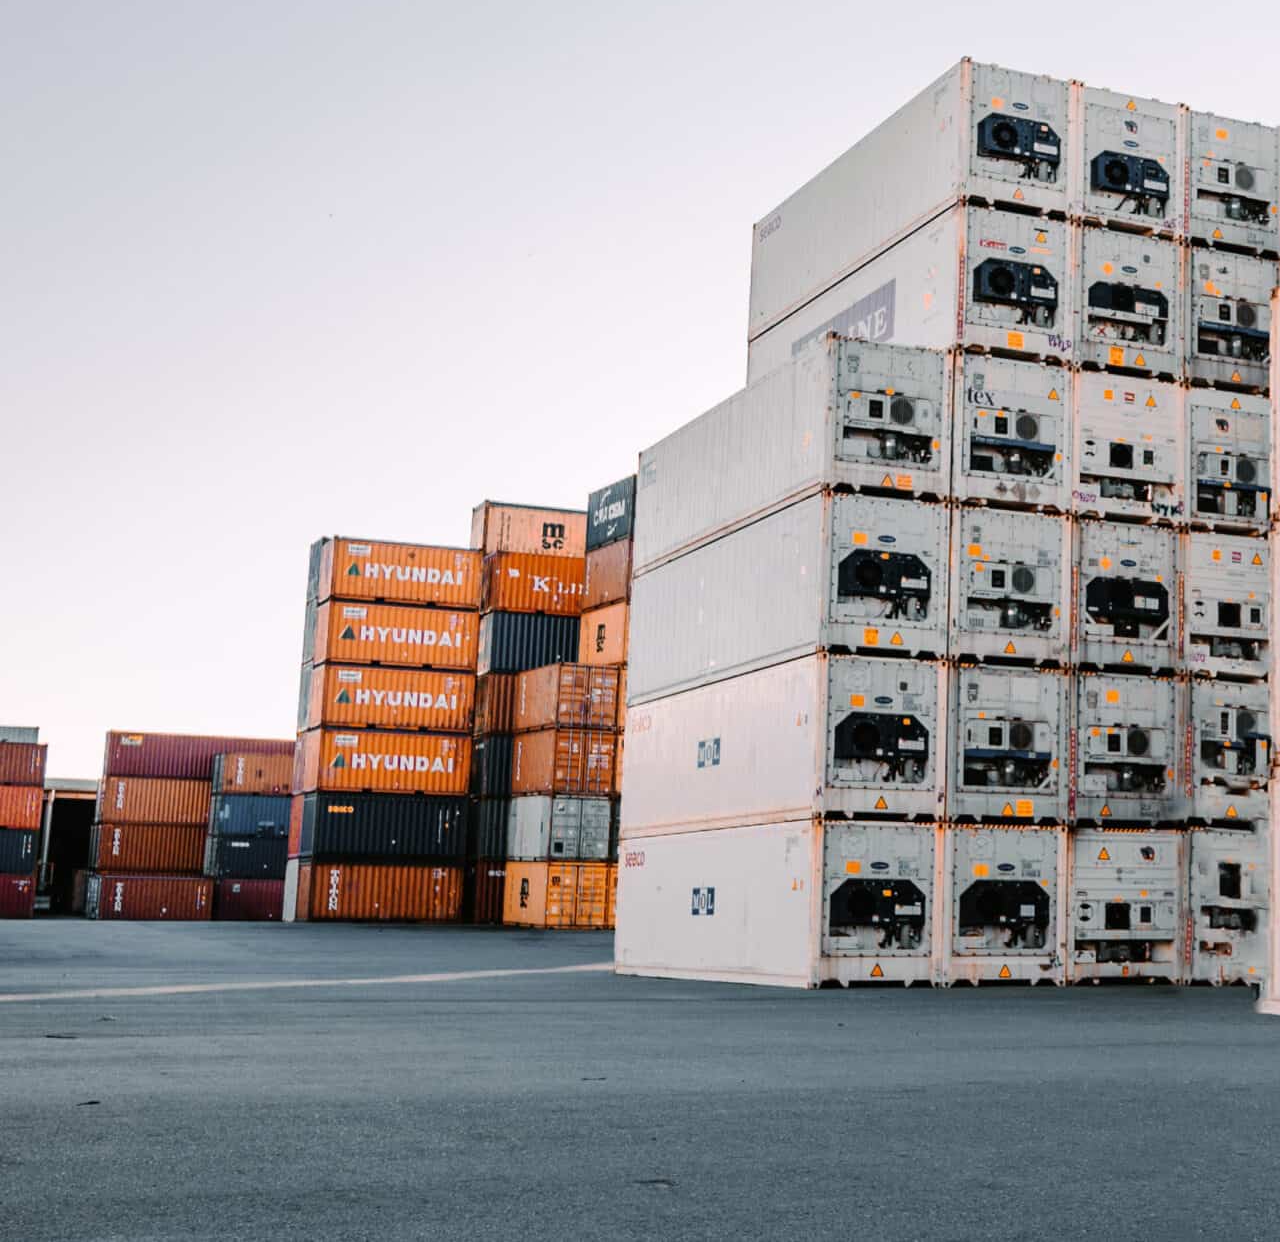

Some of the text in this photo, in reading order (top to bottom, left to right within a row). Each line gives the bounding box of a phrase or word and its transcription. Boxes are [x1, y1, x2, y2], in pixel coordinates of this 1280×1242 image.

[968, 386, 994, 406] tex
[365, 563, 464, 586] HYUNDAI
[361, 625, 462, 648] HYUNDAI
[355, 688, 457, 710] HYUNDAI
[351, 753, 454, 774] HYUNDAI
